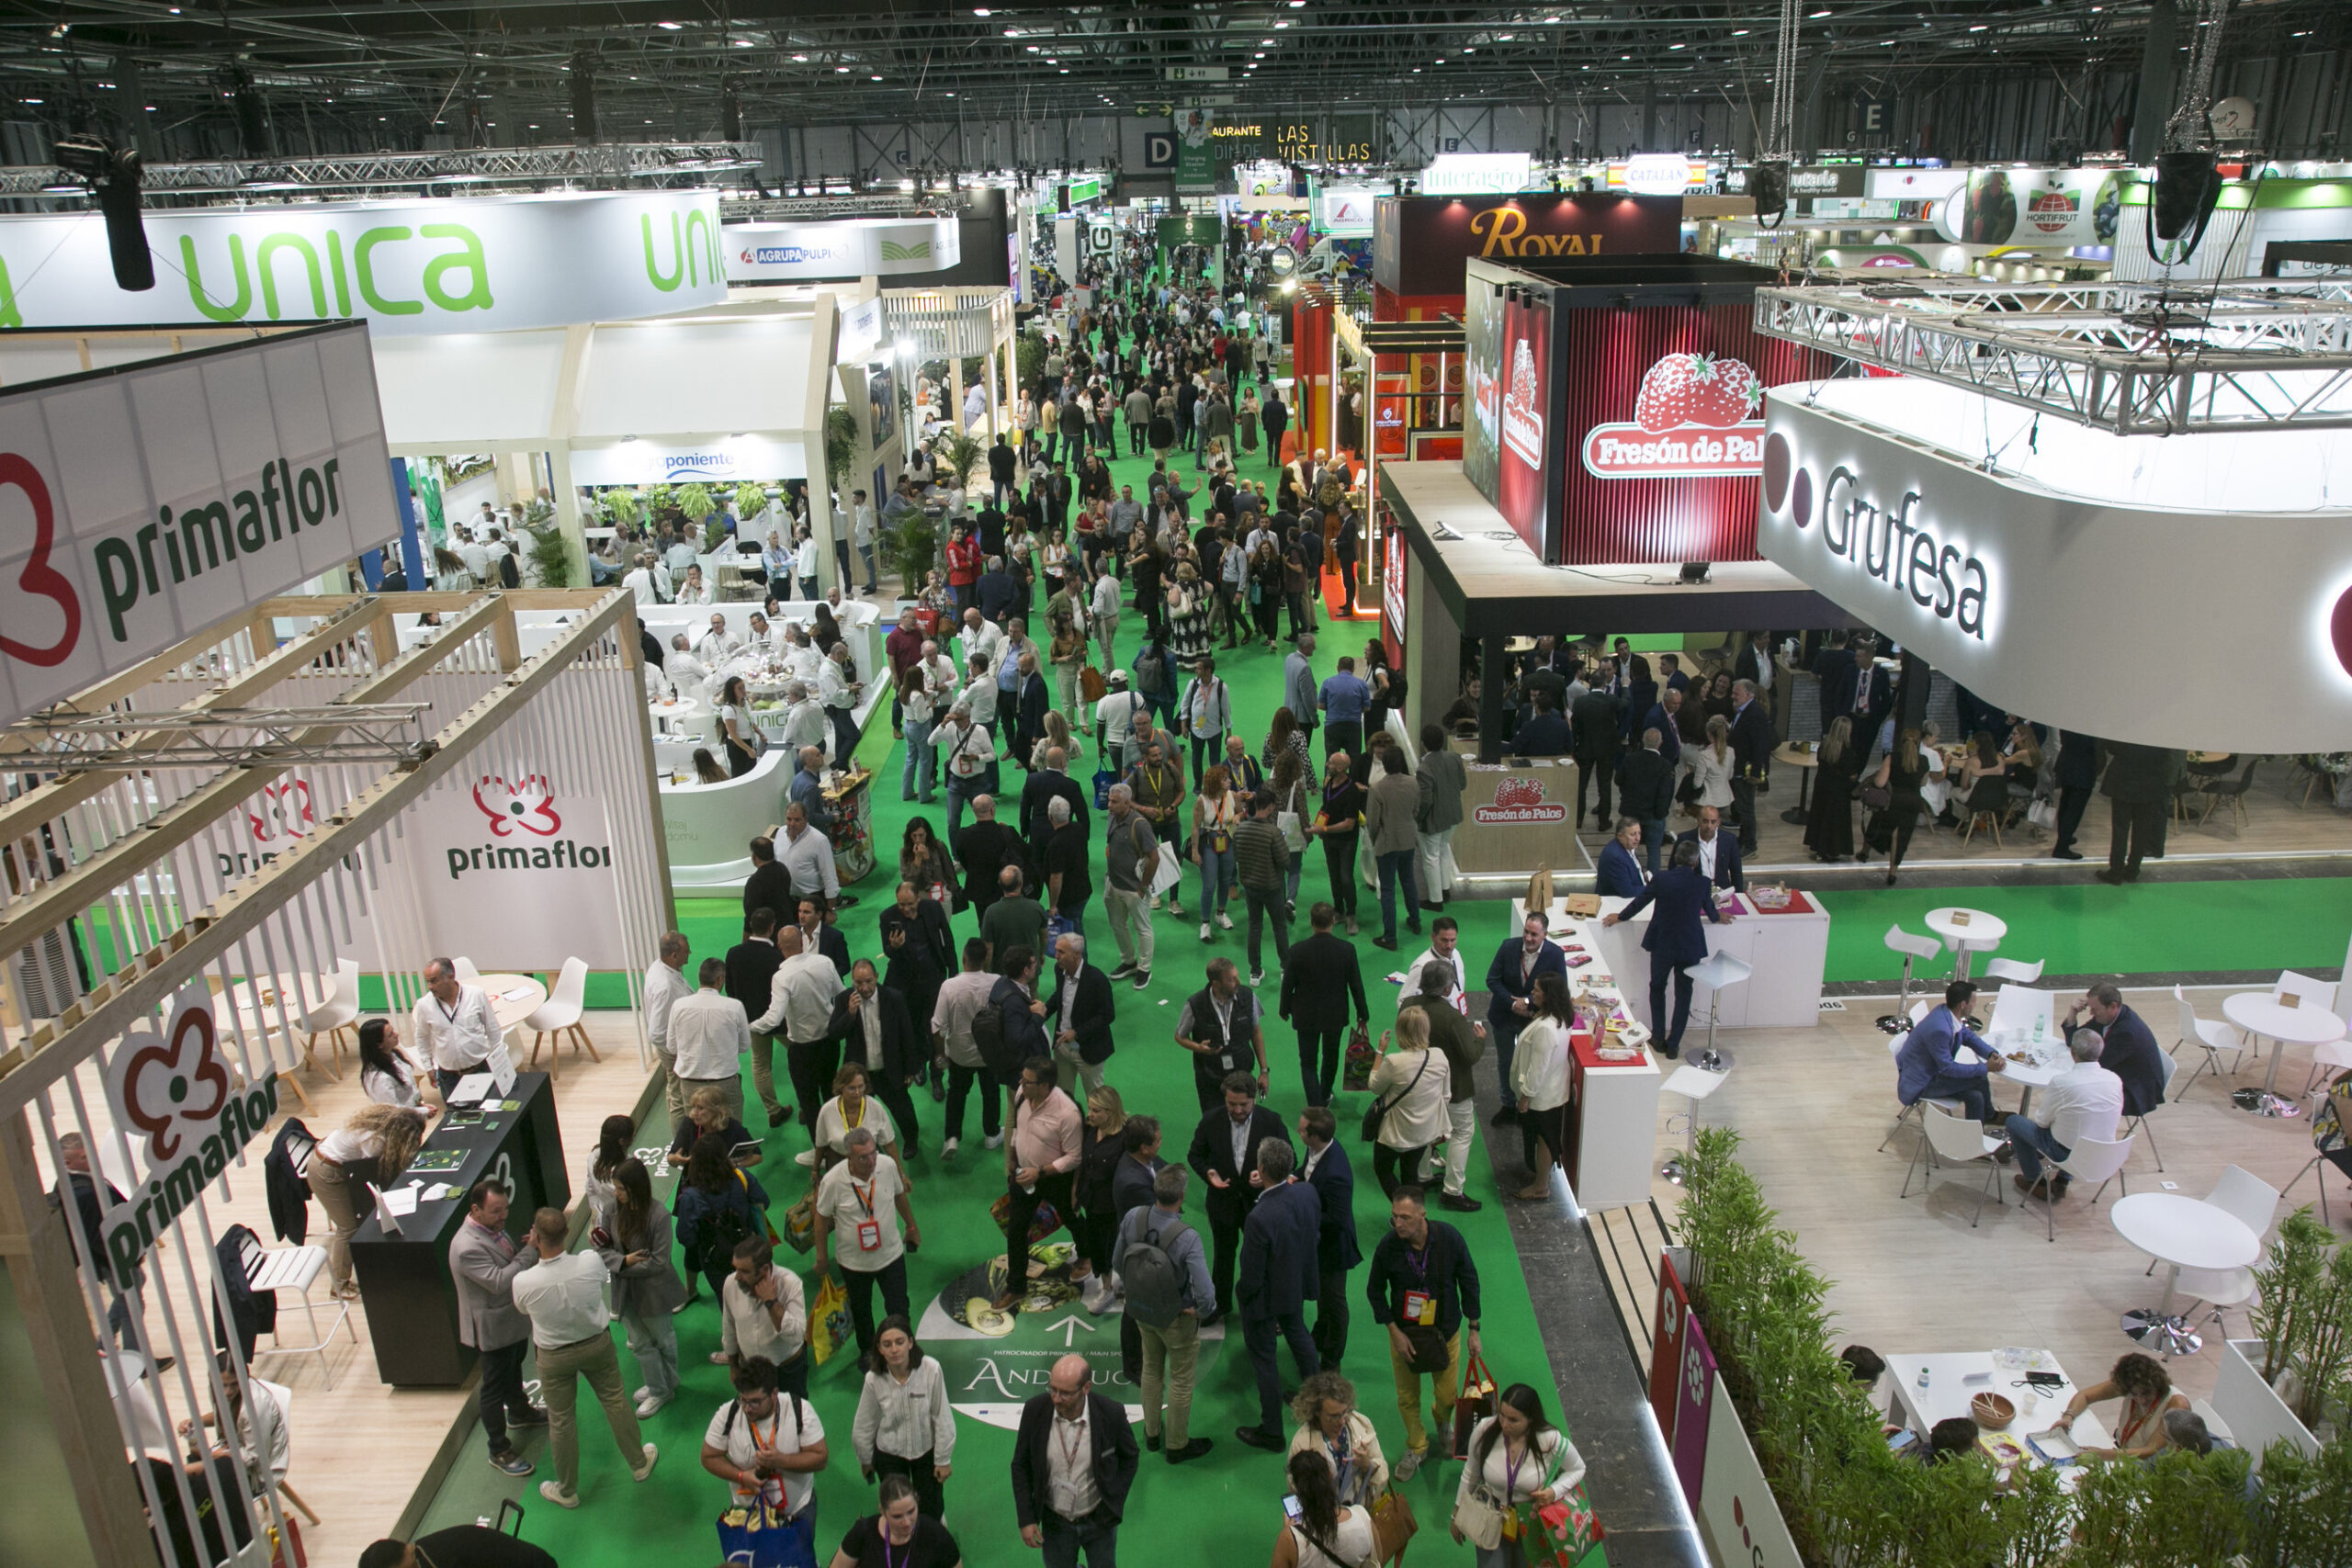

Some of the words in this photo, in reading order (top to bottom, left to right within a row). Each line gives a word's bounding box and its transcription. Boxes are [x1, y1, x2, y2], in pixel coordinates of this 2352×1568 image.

[1868, 105, 1882, 129] E
[1278, 125, 1308, 142] LAS
[1448, 140, 1455, 151] E
[1151, 138, 1172, 163] D
[1278, 143, 1370, 161] VISTLLAS
[1630, 167, 1684, 181] CATALAN
[2026, 213, 2078, 221] HORTIFRUT
[1597, 436, 1691, 466] Fresón
[1696, 438, 1723, 462] de
[94, 457, 339, 642] primaflor
[1823, 466, 1987, 640] Grufesa
[1477, 807, 1517, 820] Fresón
[1518, 808, 1530, 819] de
[1532, 807, 1563, 819] Palos
[447, 840, 610, 879] primaflor
[107, 1072, 279, 1292] primaflor
